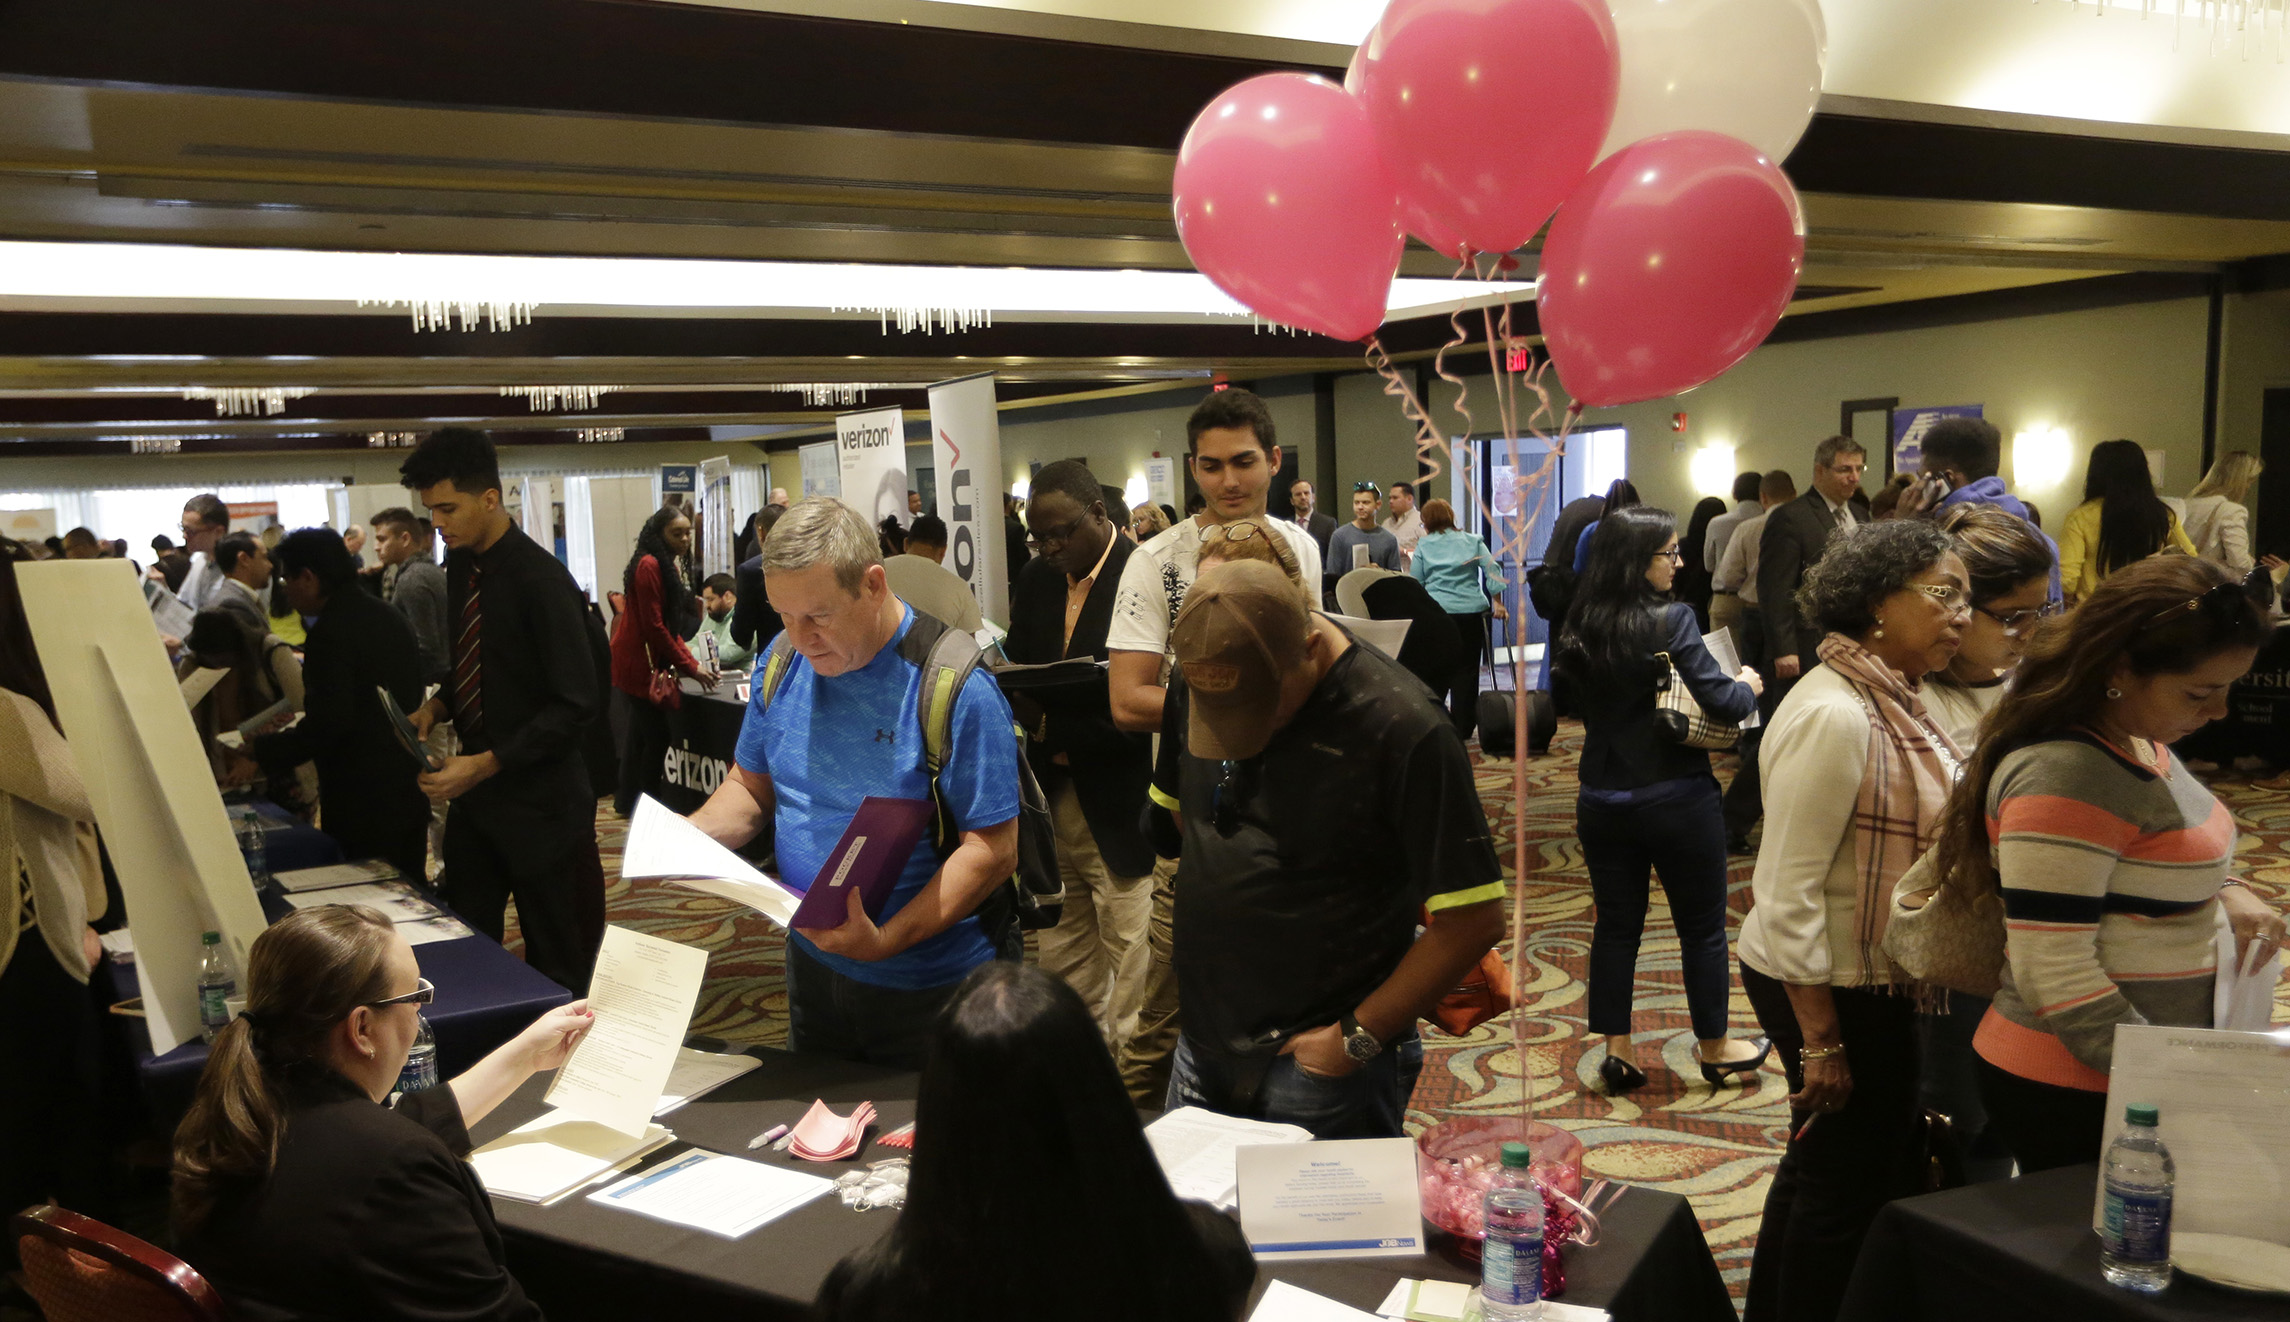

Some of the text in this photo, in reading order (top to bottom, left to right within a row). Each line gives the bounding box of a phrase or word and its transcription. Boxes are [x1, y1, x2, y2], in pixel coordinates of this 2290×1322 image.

[841, 424, 889, 450] verizon
[951, 469, 976, 598] on
[661, 739, 728, 795] erizon
